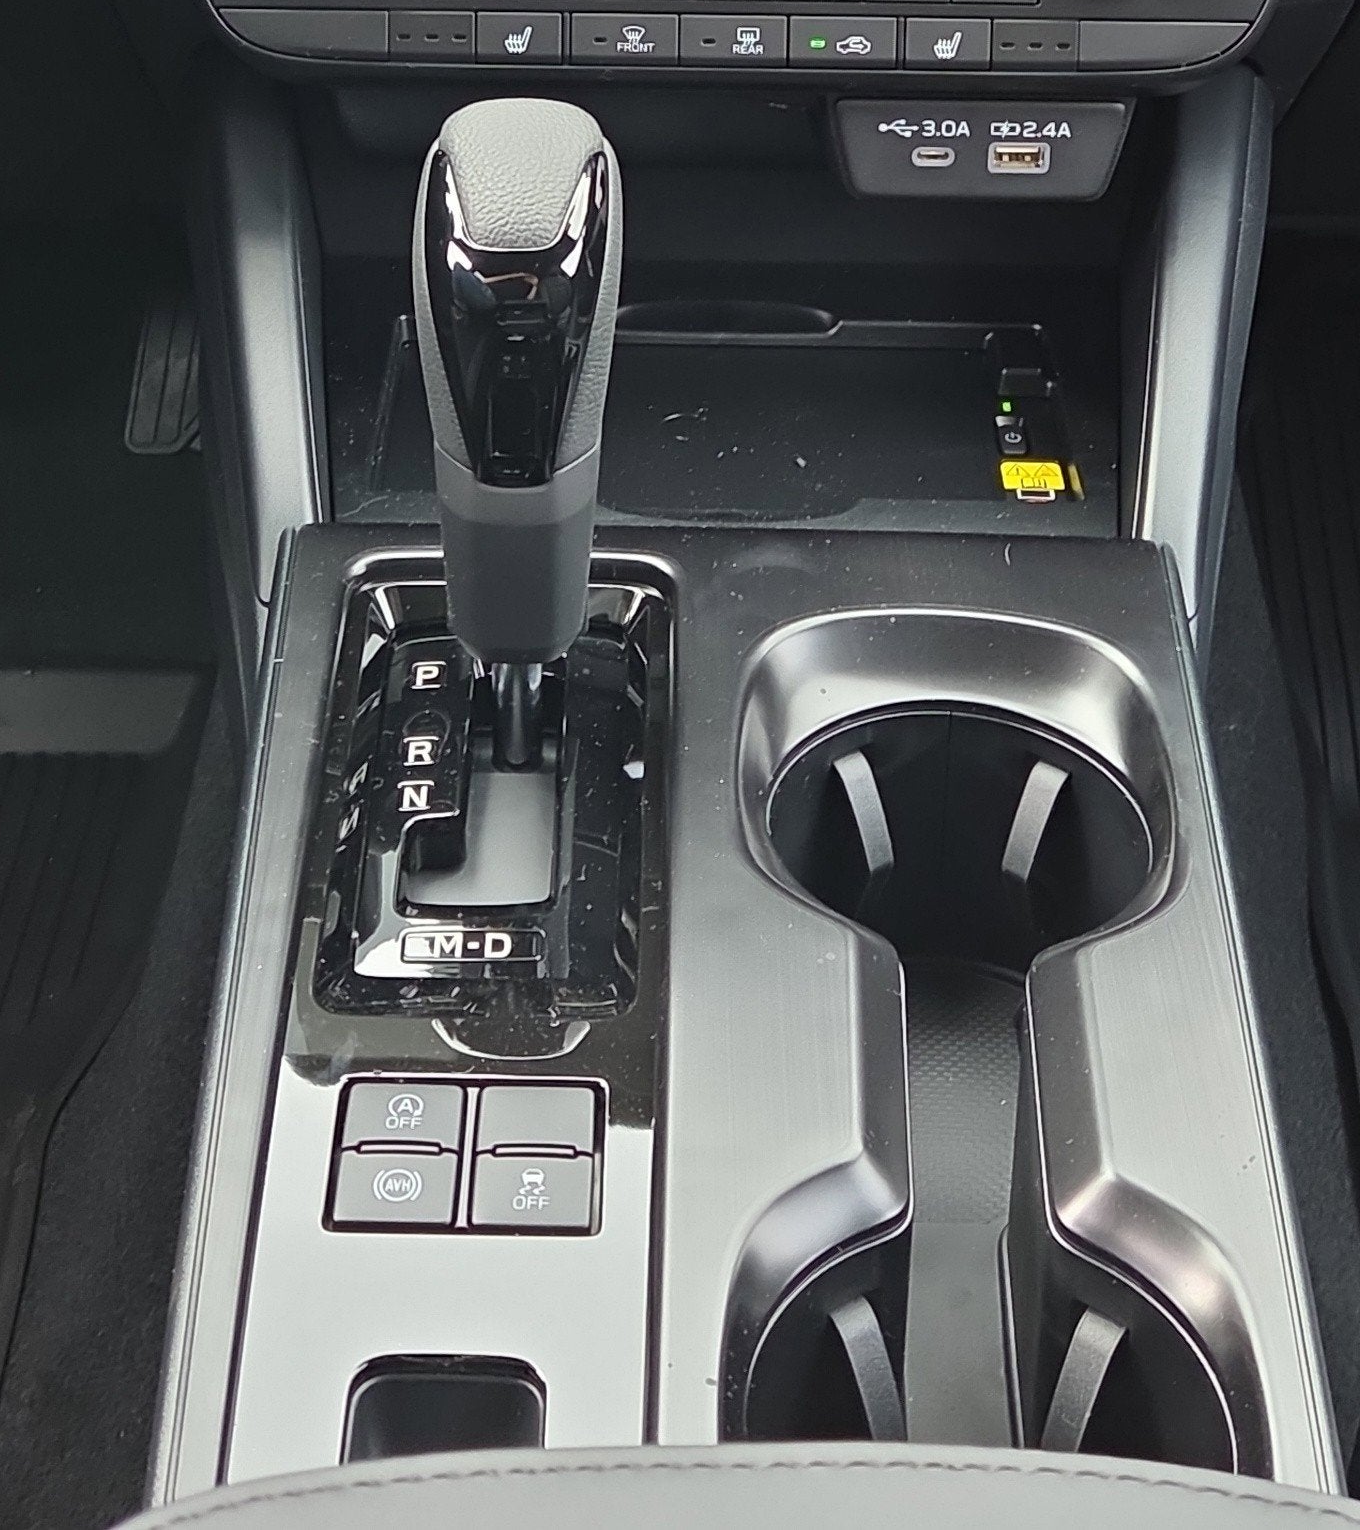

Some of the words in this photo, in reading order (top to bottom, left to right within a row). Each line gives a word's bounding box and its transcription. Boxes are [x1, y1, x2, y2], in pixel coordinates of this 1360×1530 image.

[616, 41, 656, 53] FRONT
[732, 44, 764, 55] REAR
[921, 120, 971, 137] 3.0A
[1022, 121, 1072, 138] 2.4A
[415, 667, 439, 686] P
[407, 742, 435, 763] R
[402, 786, 429, 808] N
[385, 1116, 423, 1130] OFF
[384, 1178, 411, 1193] AVH
[512, 1196, 551, 1210] OFF
